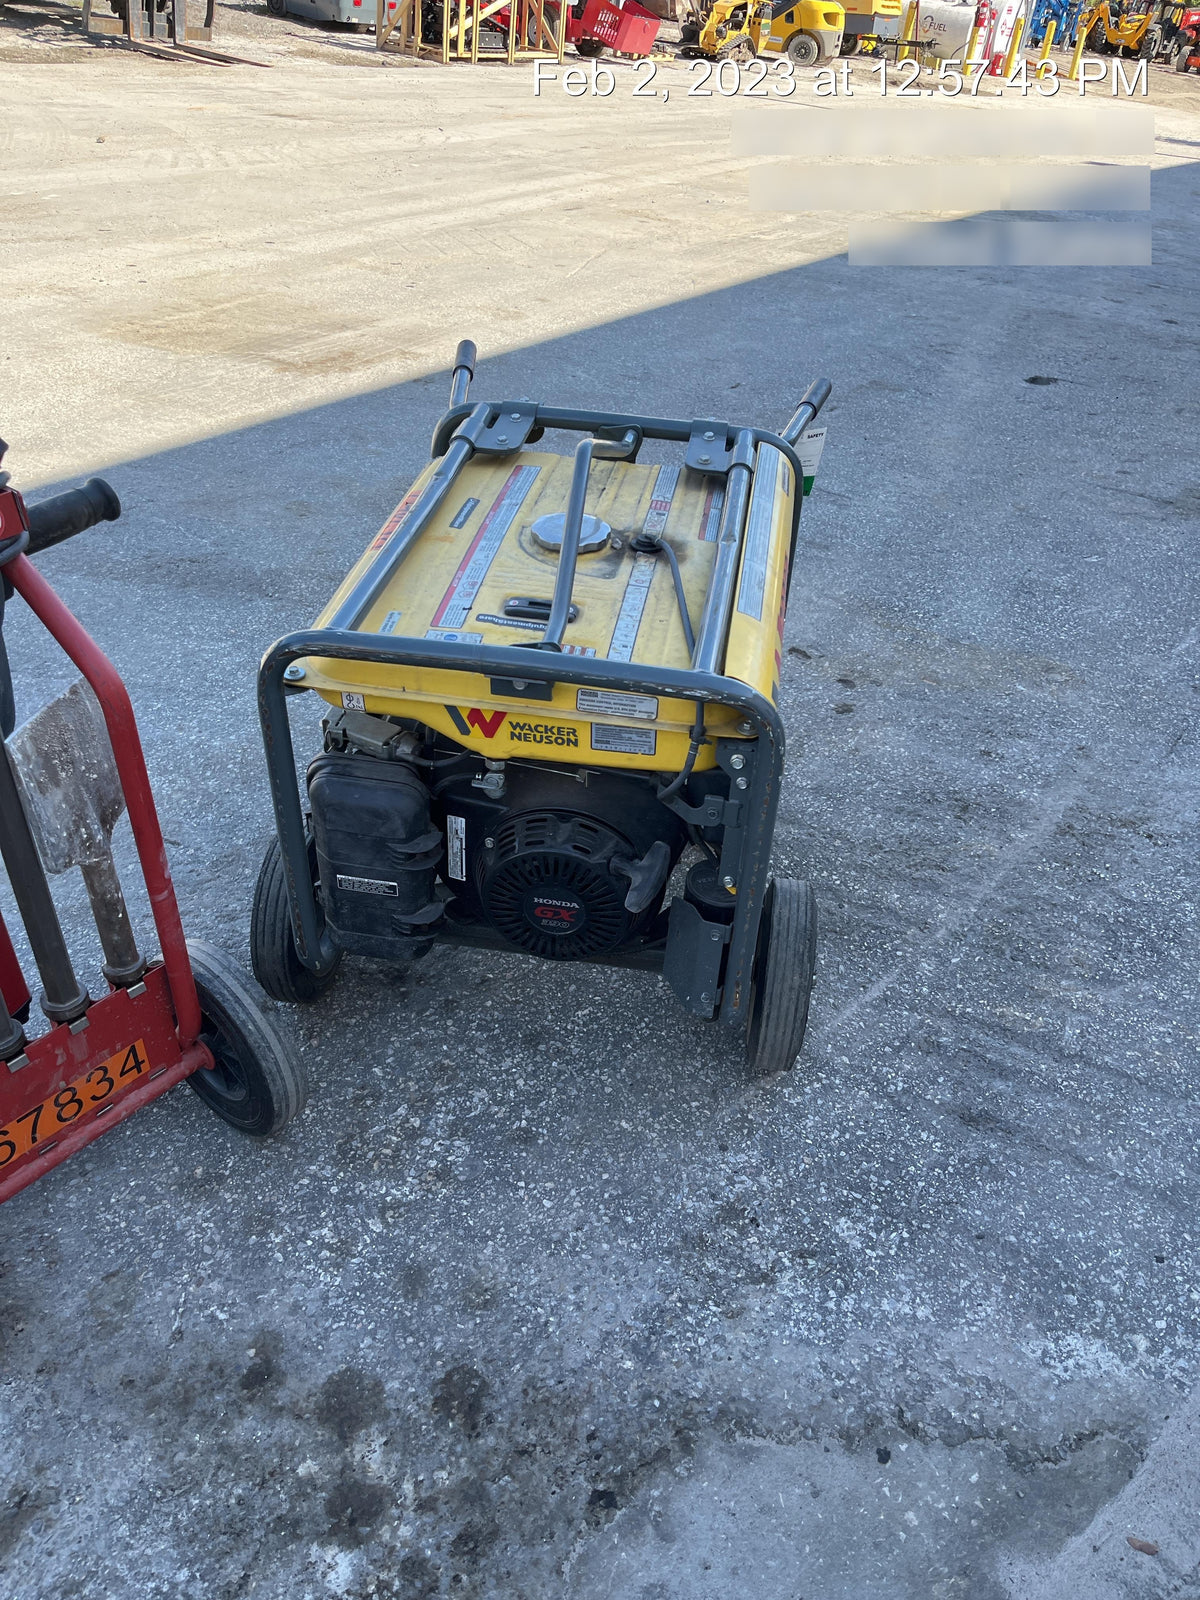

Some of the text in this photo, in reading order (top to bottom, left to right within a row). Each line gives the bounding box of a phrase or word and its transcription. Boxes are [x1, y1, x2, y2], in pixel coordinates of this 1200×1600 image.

[928, 21, 947, 32] FUEL
[478, 614, 548, 630] quipmentShare
[508, 721, 578, 737] WACKER
[510, 731, 579, 747] NEUSON
[533, 897, 580, 908] HONDA
[534, 906, 578, 922] GX
